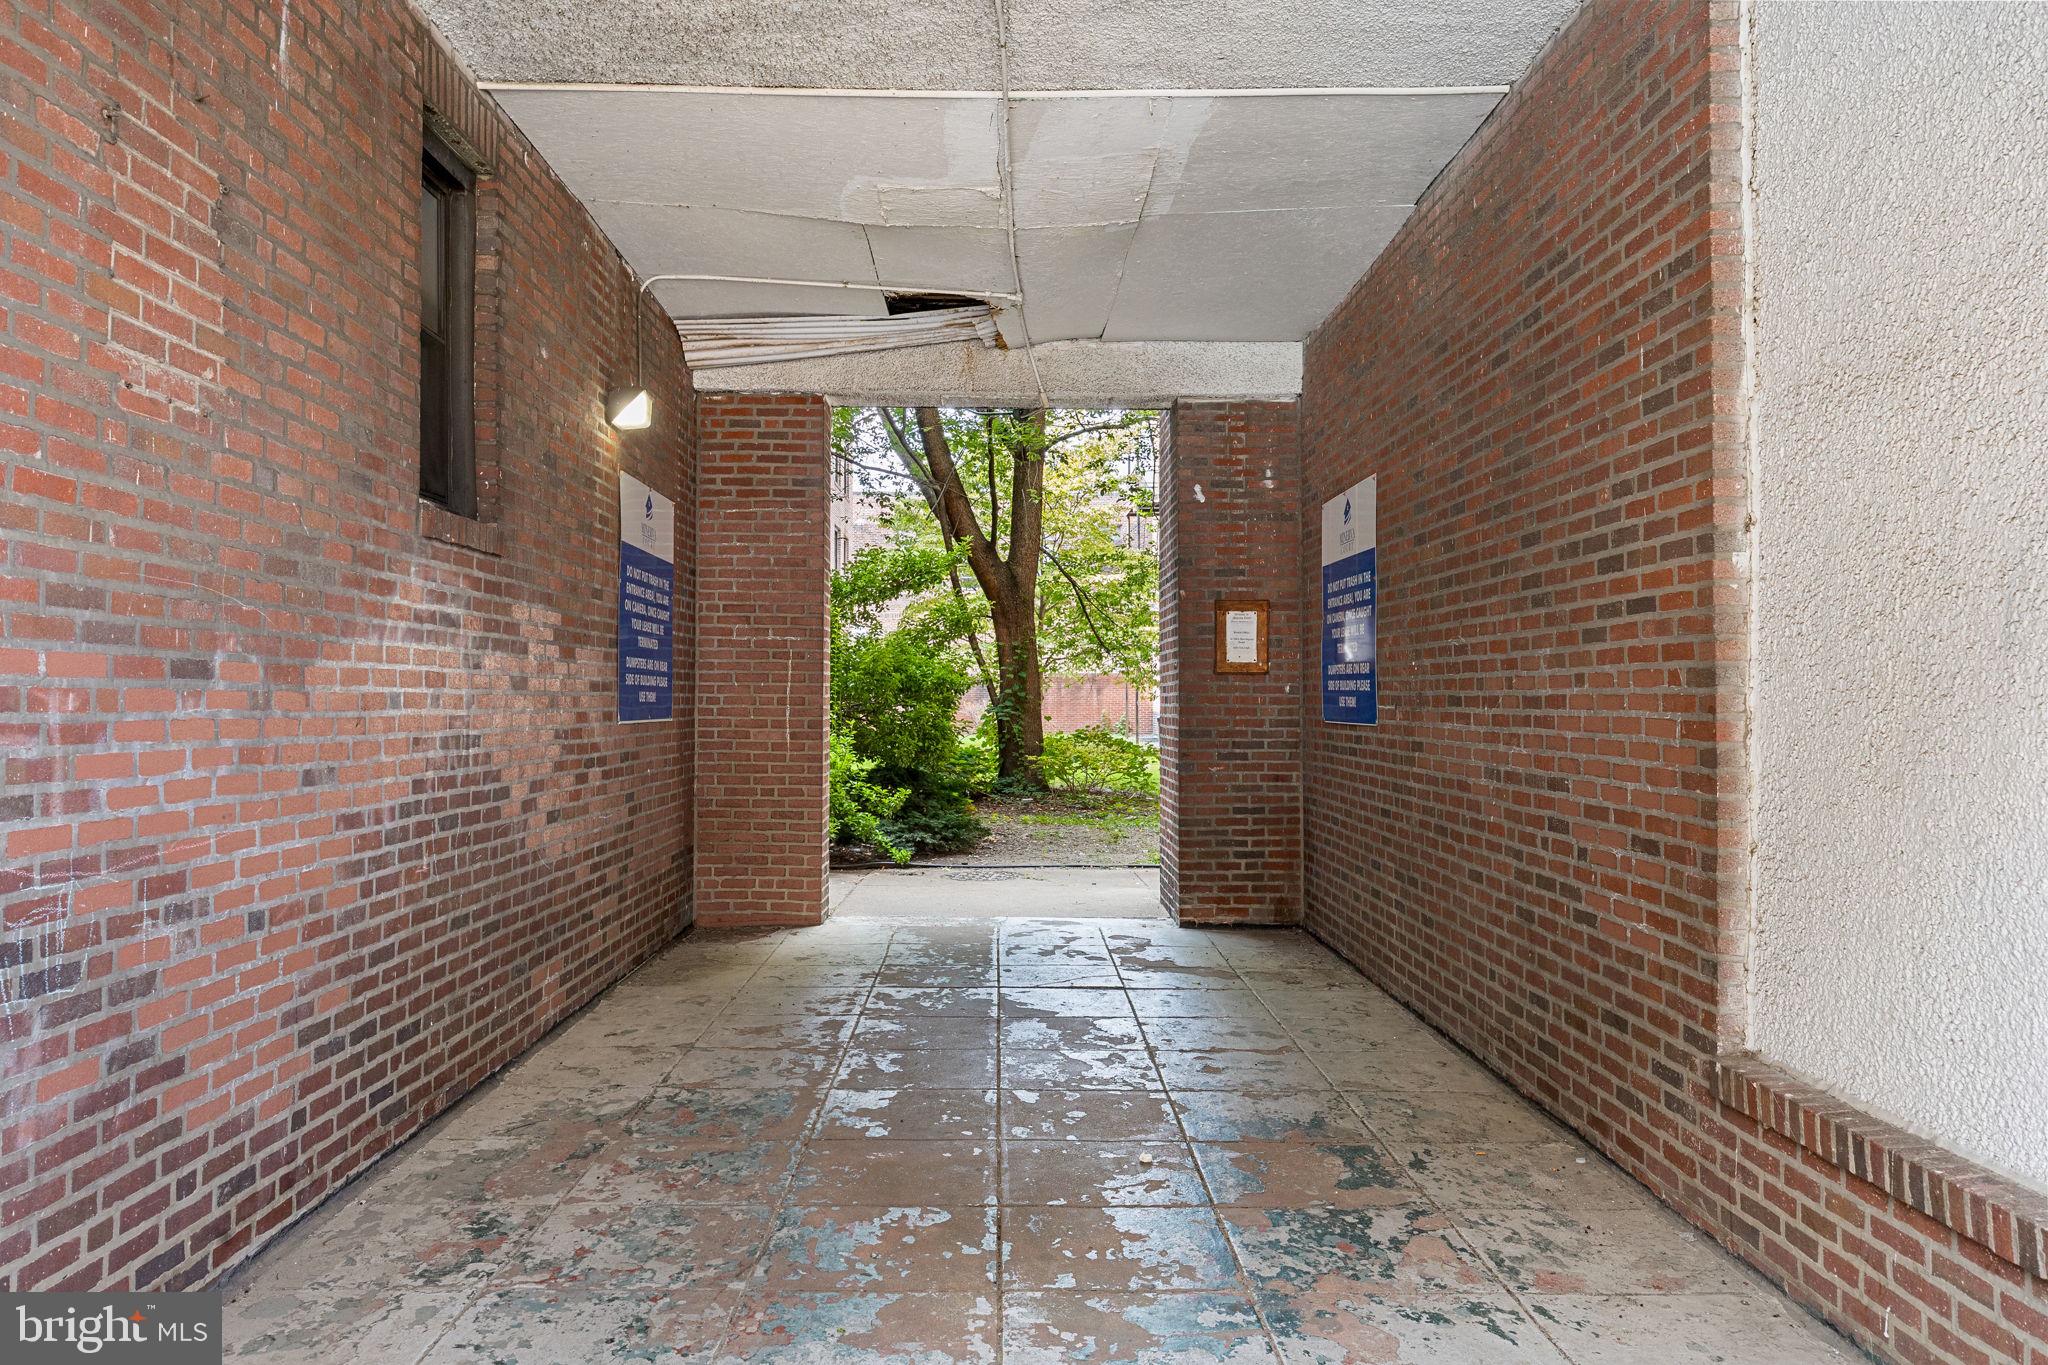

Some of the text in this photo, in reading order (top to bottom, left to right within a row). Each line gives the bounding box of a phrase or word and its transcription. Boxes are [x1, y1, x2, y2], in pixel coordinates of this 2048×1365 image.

[627, 565, 633, 577] DO
[633, 568, 641, 580] NOT
[649, 574, 658, 586] TRASH
[1328, 583, 1332, 593] DO
[1347, 575, 1357, 588] TRASH
[1358, 573, 1362, 584] IN
[1363, 571, 1371, 582] THE
[626, 582, 644, 598] ENTRANCE
[1328, 596, 1343, 609] ENTRANCE
[1354, 591, 1363, 603] YOU
[625, 599, 631, 611] ON
[648, 606, 656, 618] ONCE
[1356, 605, 1372, 618] CAUGHT
[632, 618, 641, 630] YOUR
[642, 621, 651, 632] LEASE
[660, 625, 664, 635] BE
[1332, 628, 1340, 638] YOUR
[1360, 623, 1364, 635] BE
[626, 656, 646, 669] DUMPSTERS
[654, 660, 659, 670] ON
[1328, 664, 1345, 675] DUMPSTERS
[1353, 663, 1359, 674] ON
[1360, 663, 1370, 674] REAR
[626, 674, 668, 687] SIDE OF BUILDING PLEASE
[1335, 680, 1339, 690] OF
[1340, 680, 1356, 691] BUILDING
[1357, 680, 1370, 691] PLEASE
